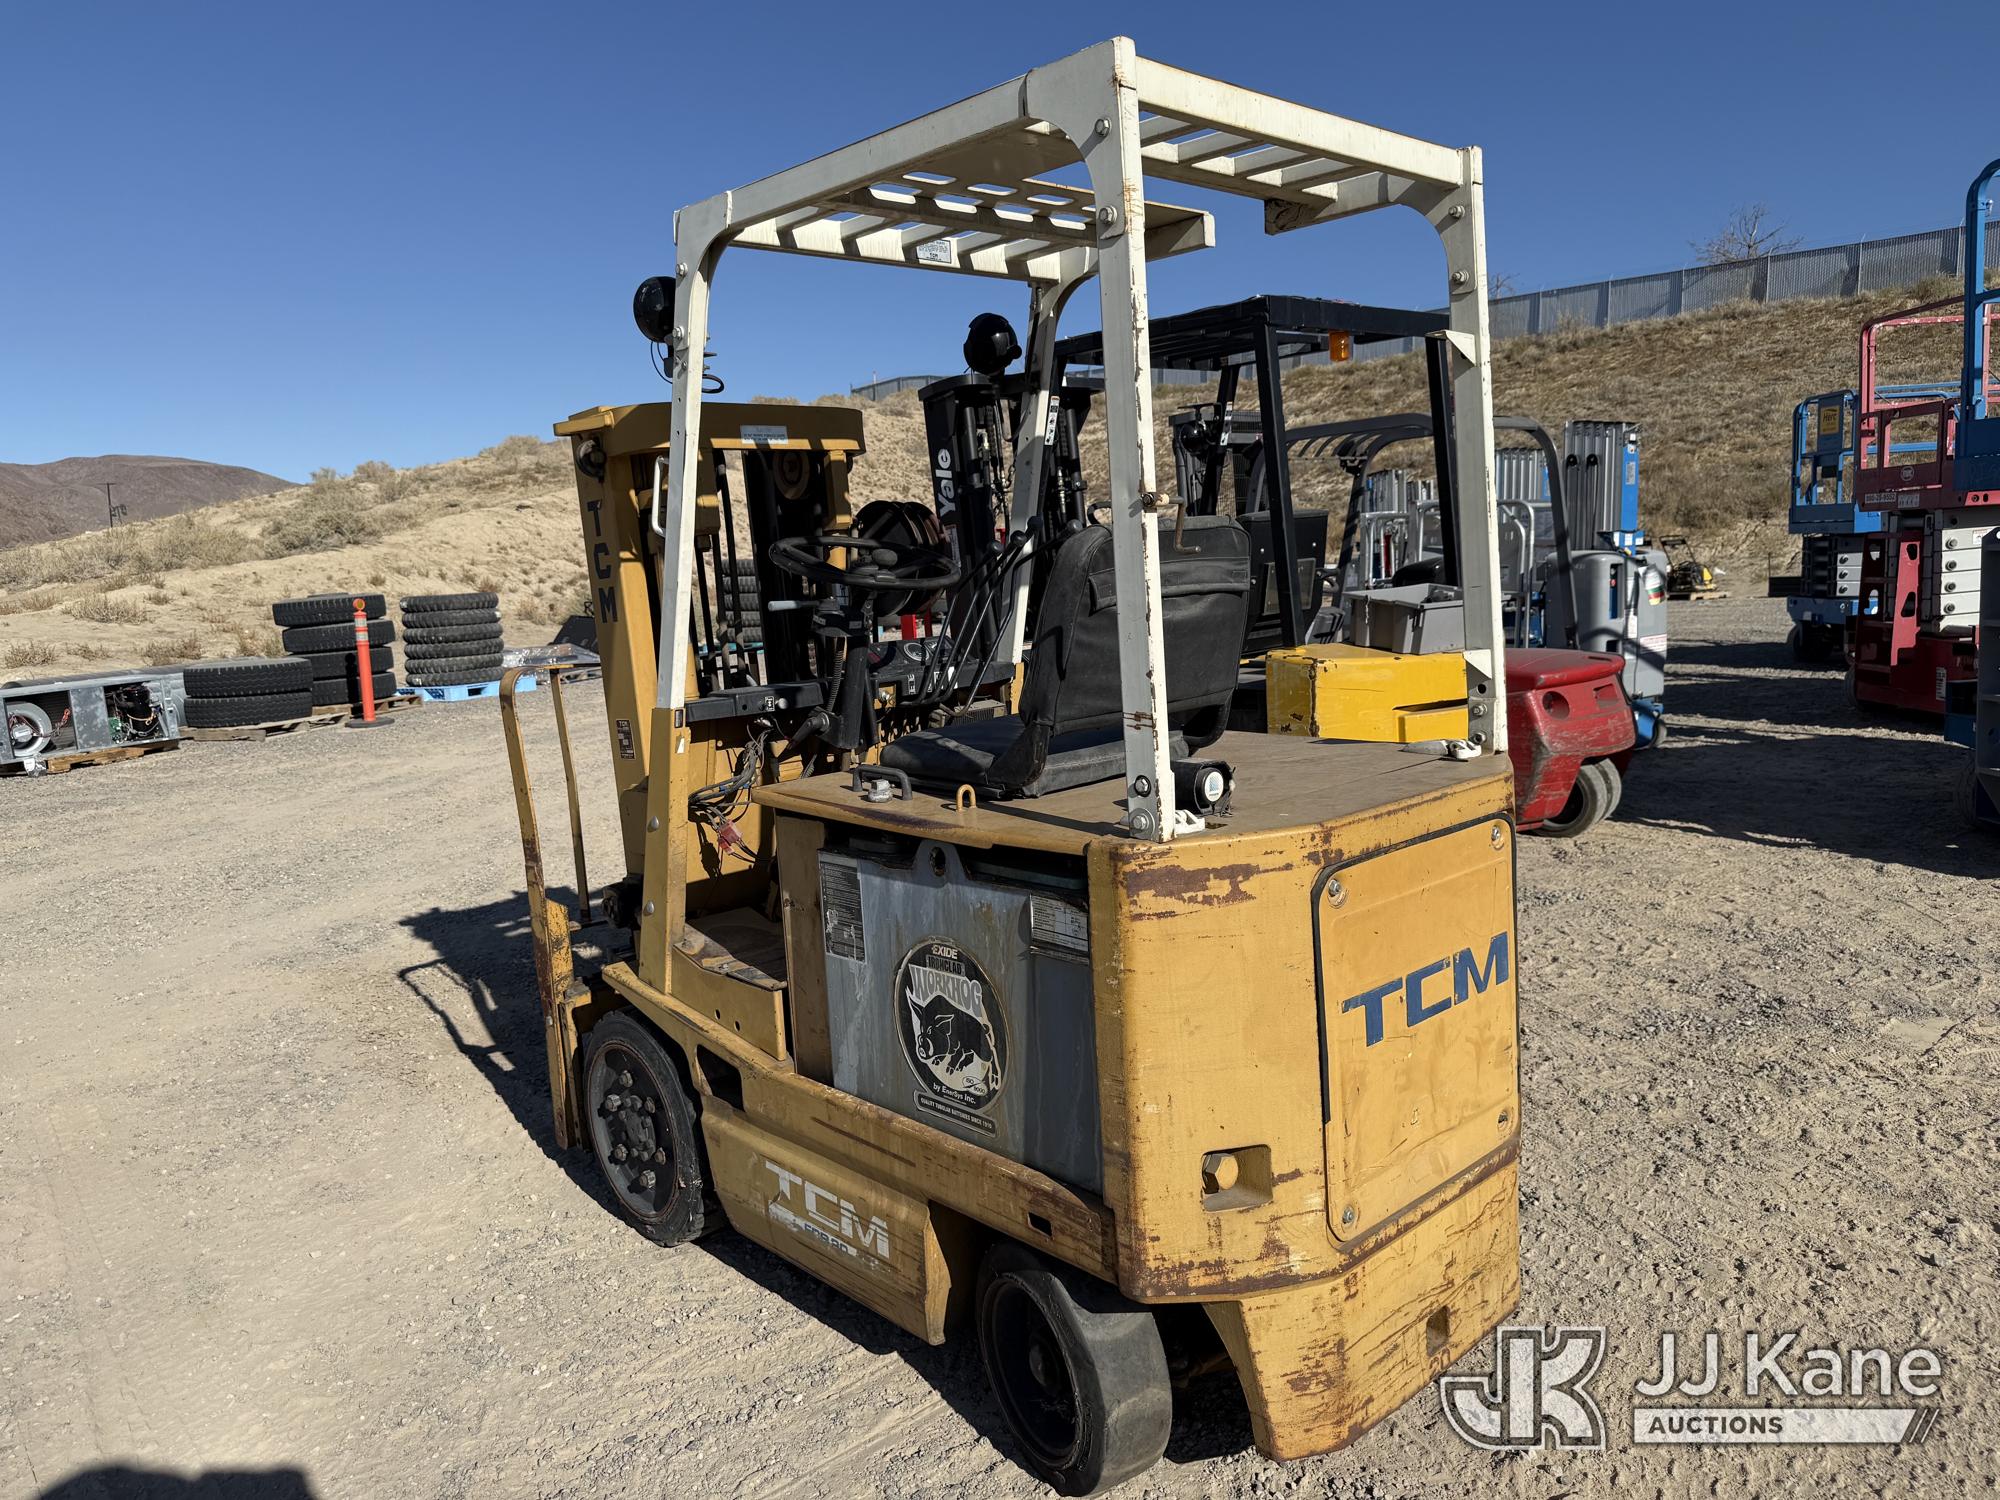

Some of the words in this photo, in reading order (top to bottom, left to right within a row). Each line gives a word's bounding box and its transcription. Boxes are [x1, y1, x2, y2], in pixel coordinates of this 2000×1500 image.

[935, 448, 956, 517] Yale
[586, 499, 618, 624] TCM
[927, 956, 964, 976] IRONCLAD
[931, 944, 959, 960] EXIDE
[909, 965, 983, 1018] WORKHOG
[1341, 931, 1509, 1048] TCM
[933, 1082, 941, 1092] by
[964, 1093, 977, 1105] Inc.
[765, 1160, 890, 1260] TCM
